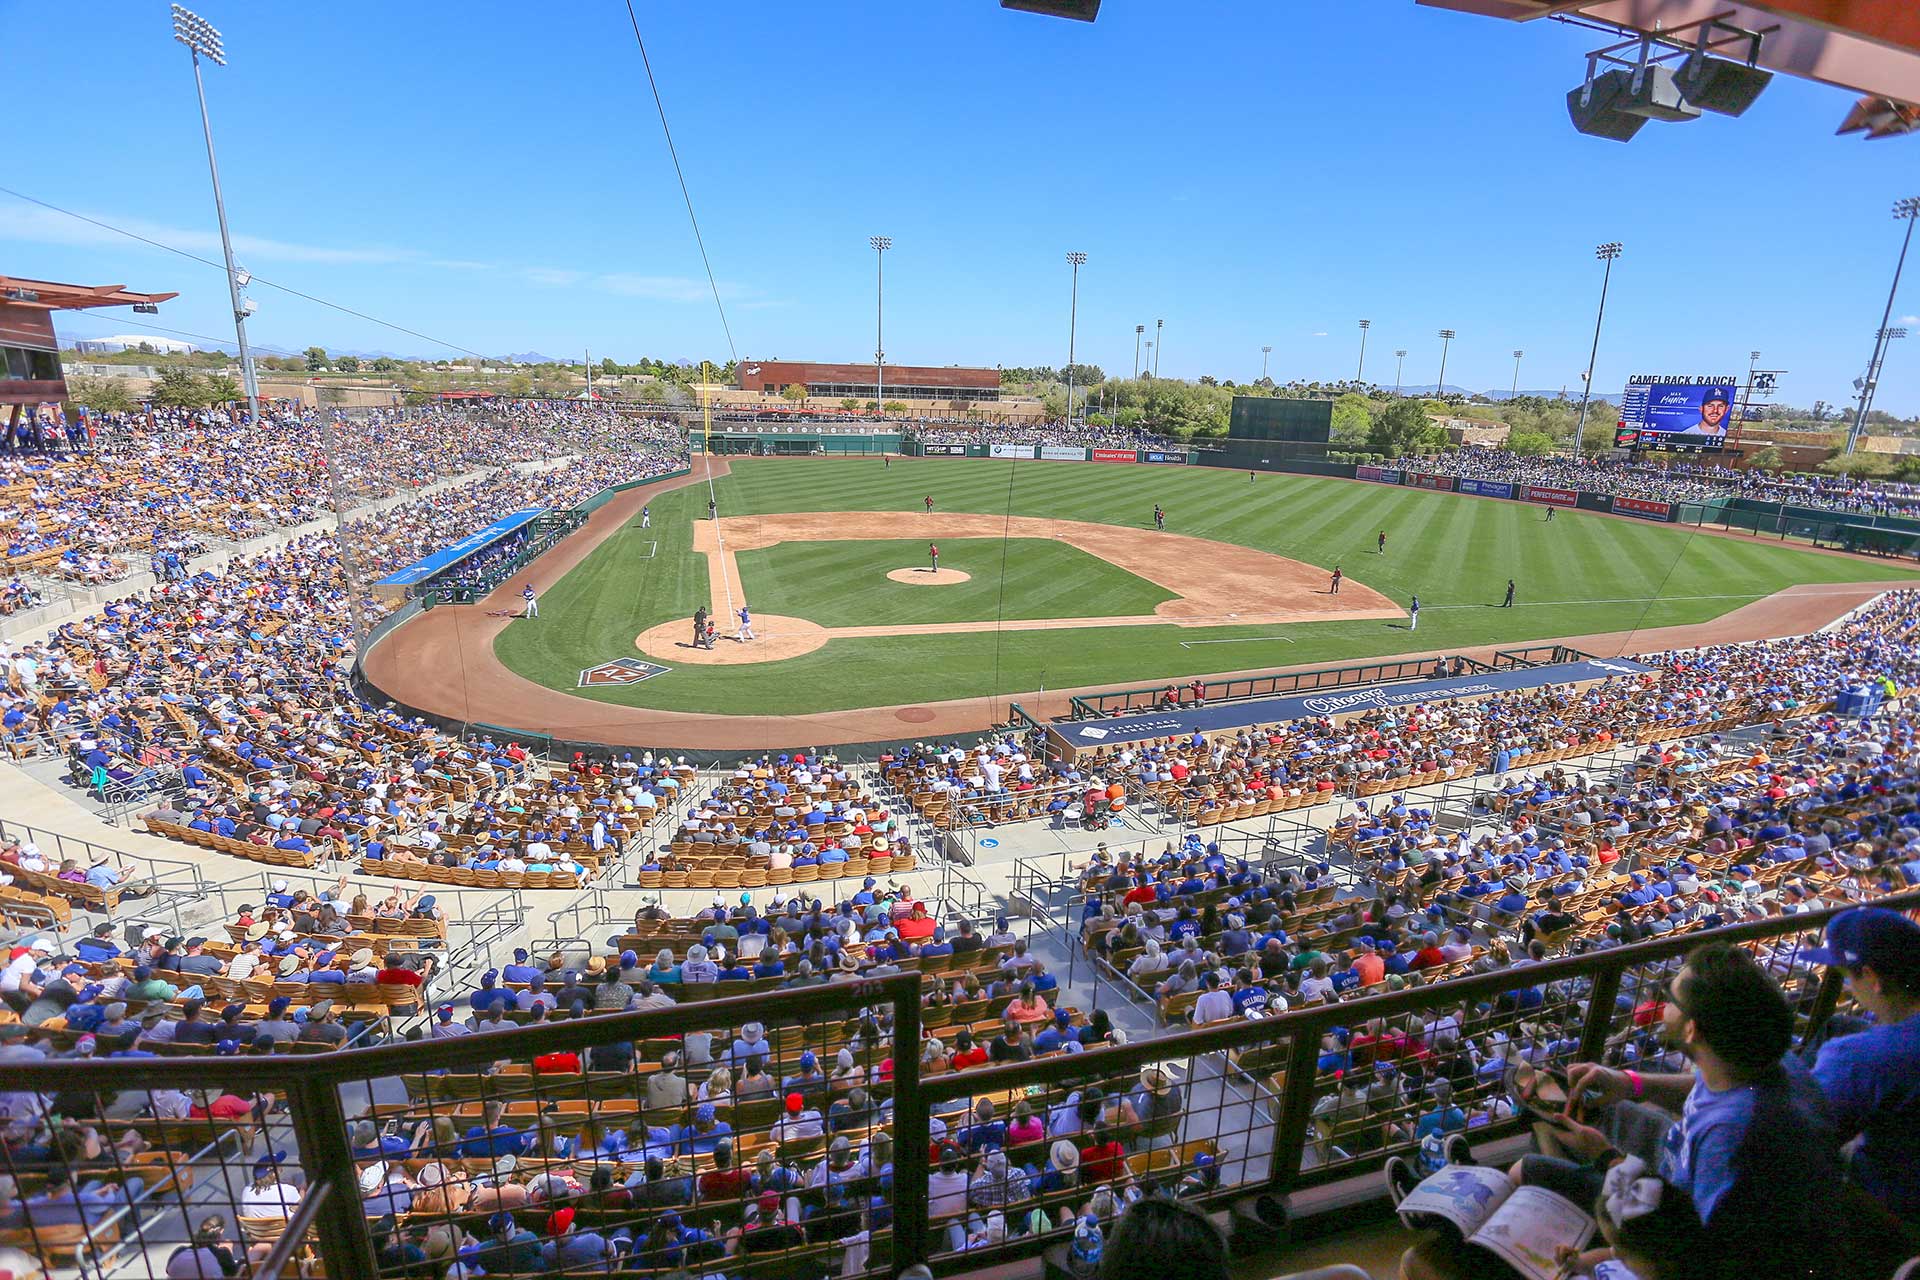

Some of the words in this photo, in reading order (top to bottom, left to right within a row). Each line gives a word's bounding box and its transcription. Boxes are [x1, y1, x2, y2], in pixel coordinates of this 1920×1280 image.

[1629, 374, 1693, 385] CAMELBACK
[1697, 376, 1737, 386] RANCH
[1481, 482, 1507, 491] Prevagen
[1530, 491, 1552, 499] PERFECT
[593, 668, 640, 681] AZ
[1302, 688, 1390, 714] Chicago
[1109, 719, 1177, 731] CAMELBACK
[1114, 726, 1153, 735] RANCH
